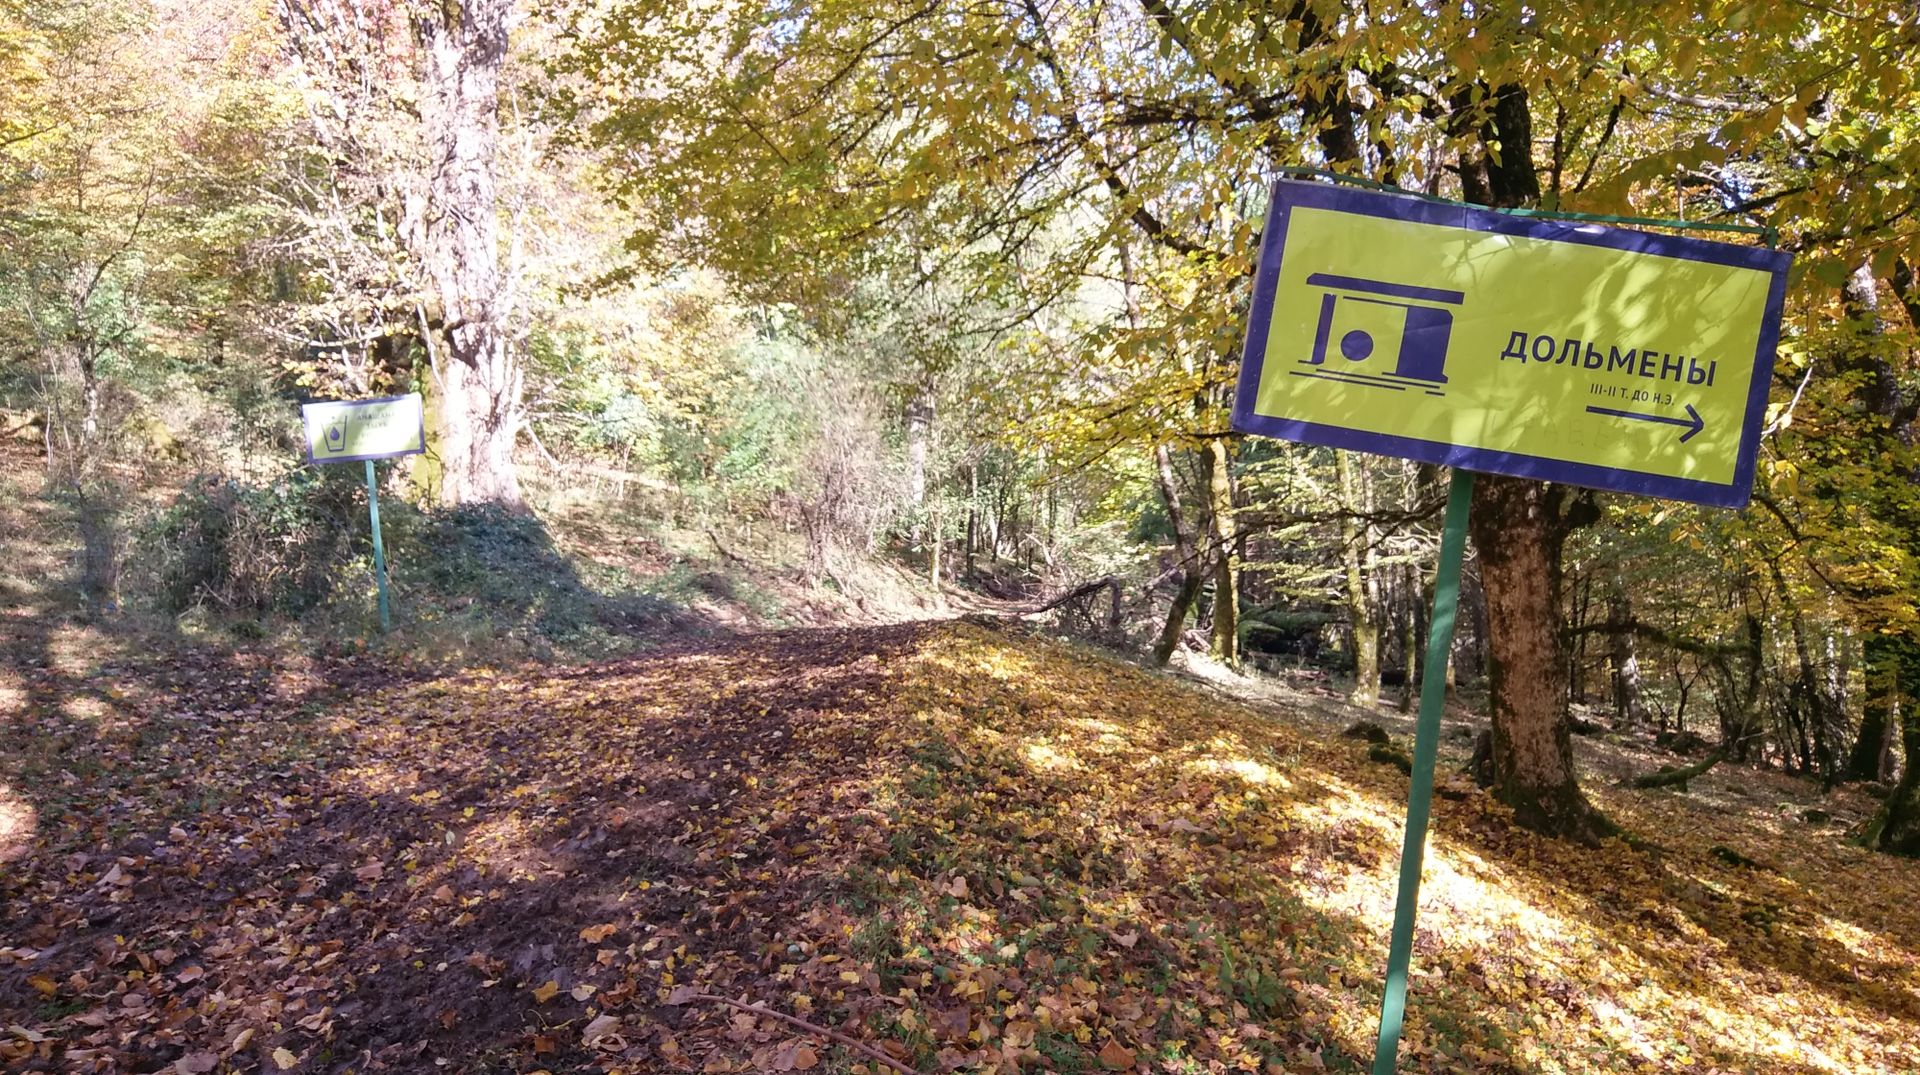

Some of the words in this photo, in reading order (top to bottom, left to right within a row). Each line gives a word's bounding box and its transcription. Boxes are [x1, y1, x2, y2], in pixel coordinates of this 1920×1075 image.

[1500, 330, 1718, 387] ДОЛЬМЕНЫ
[1631, 389, 1649, 402] ДО
[1652, 392, 1675, 406] Н.Э.
